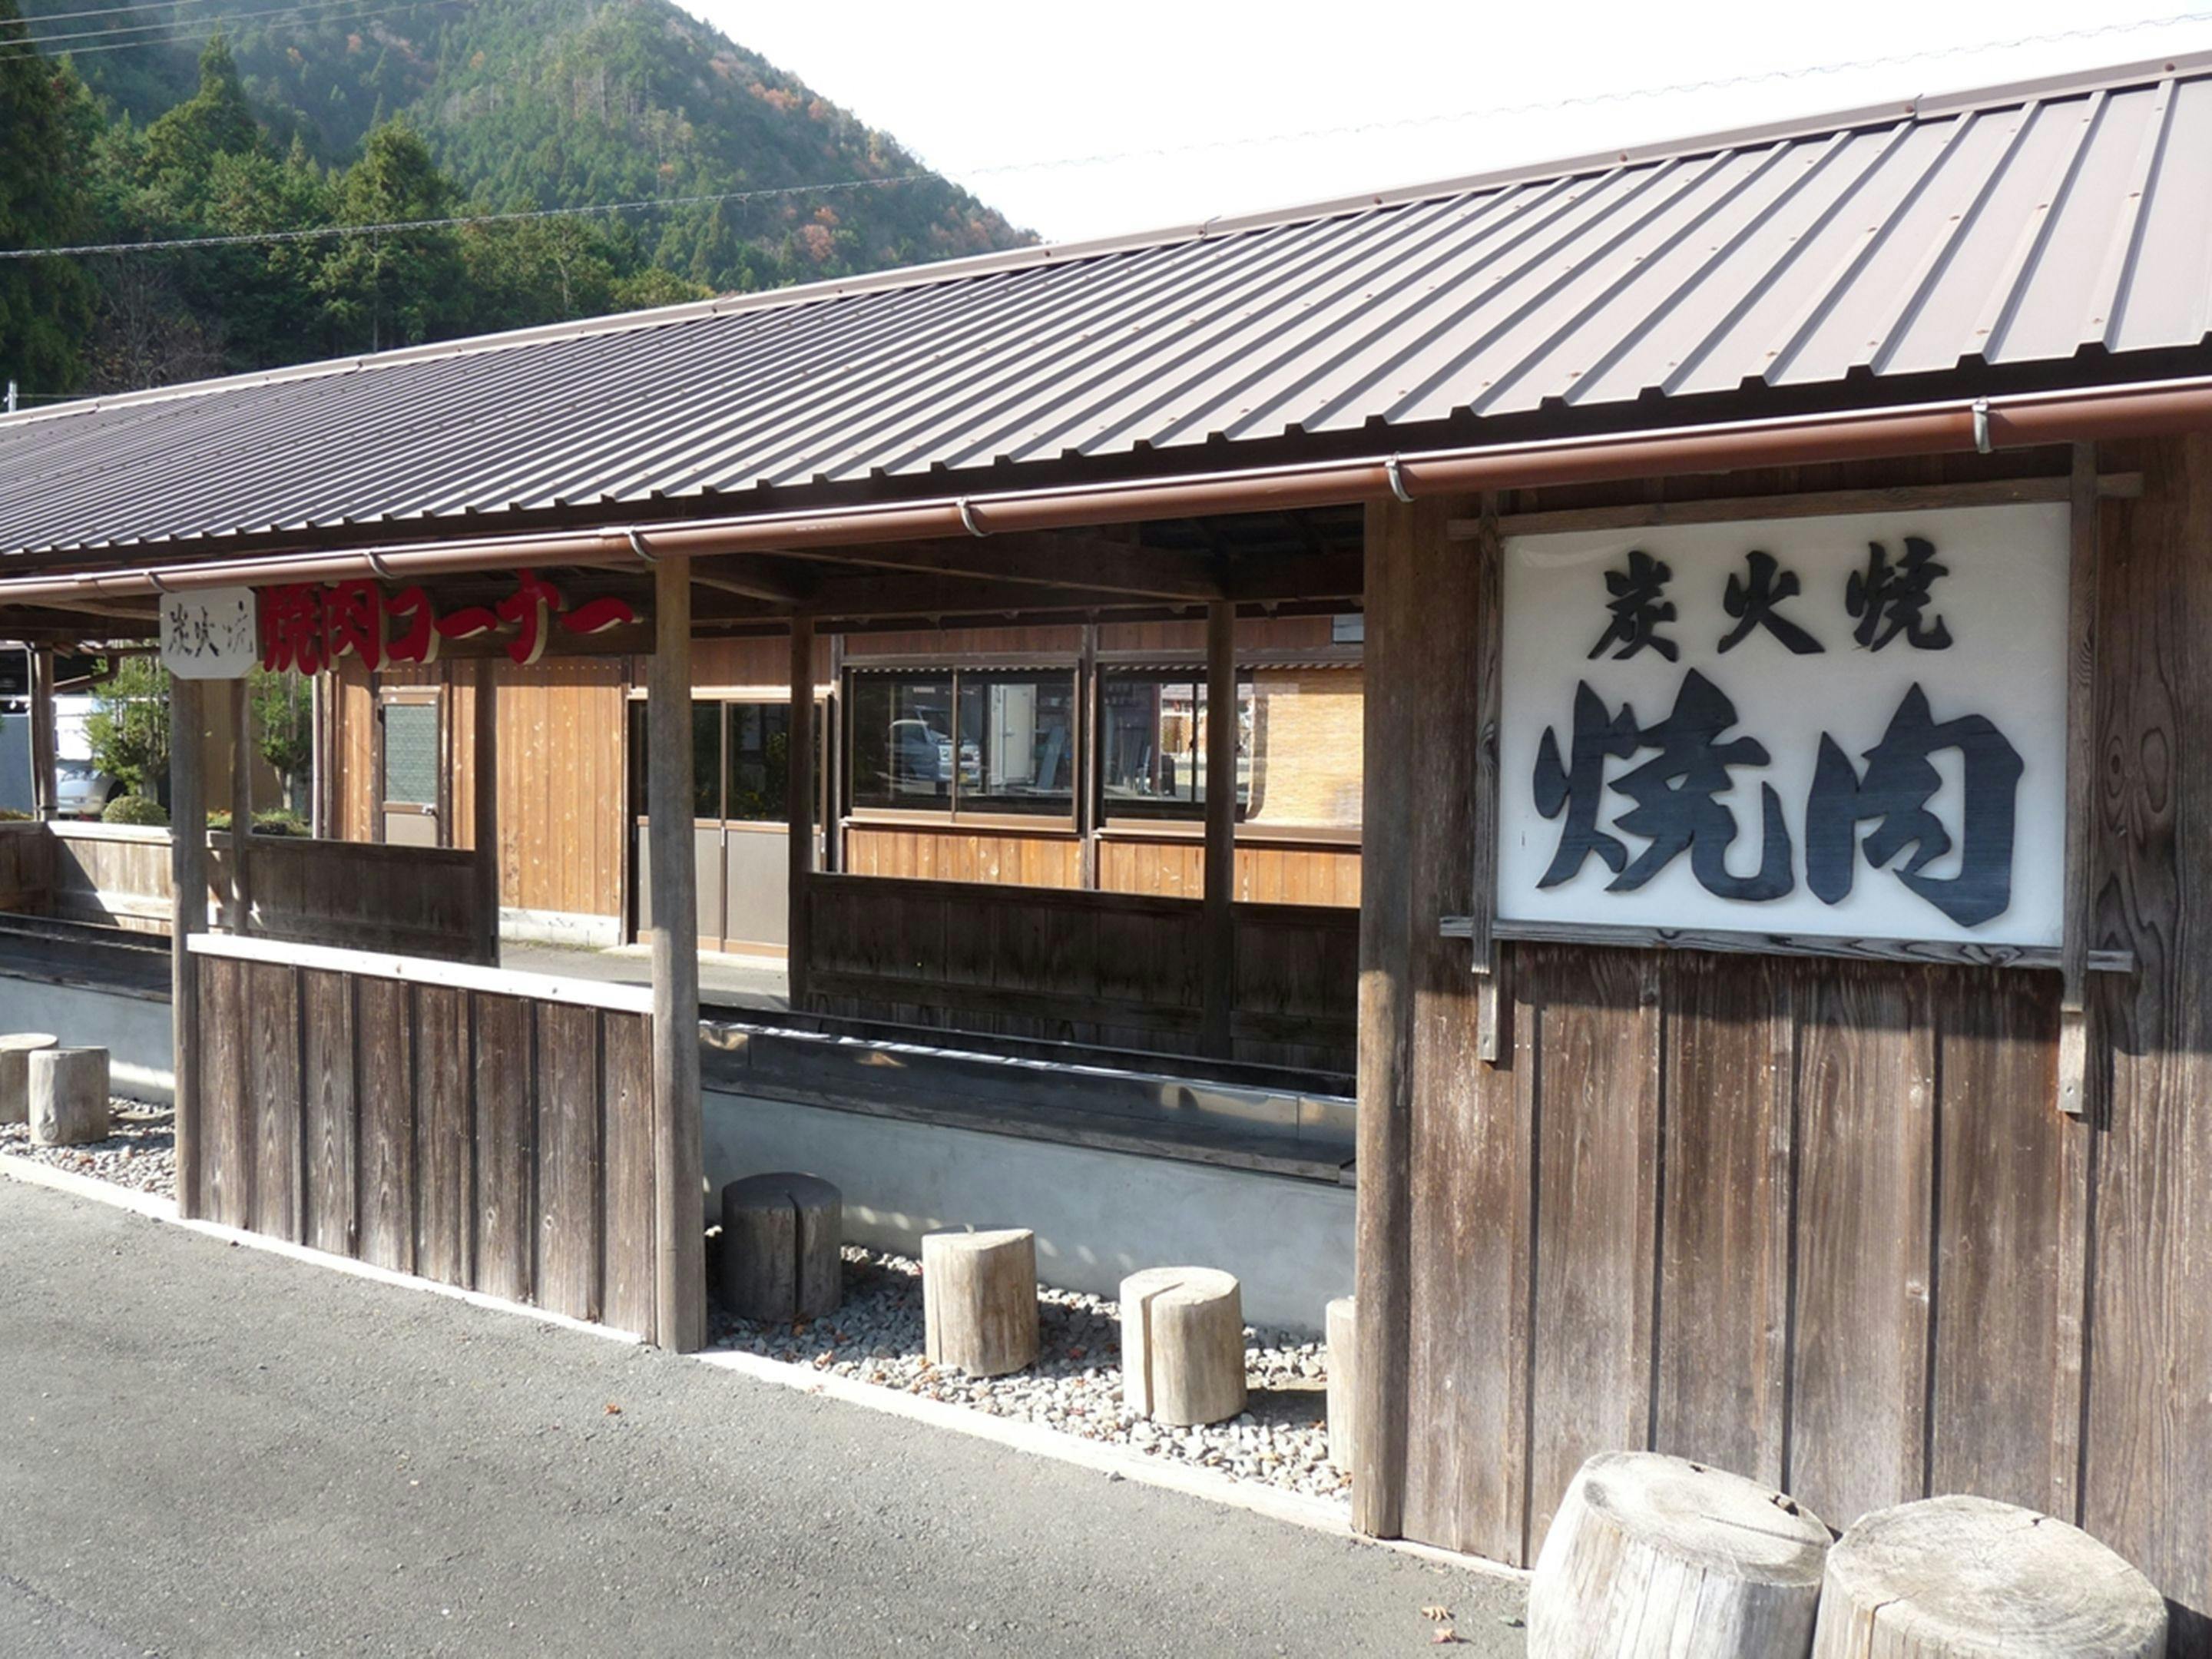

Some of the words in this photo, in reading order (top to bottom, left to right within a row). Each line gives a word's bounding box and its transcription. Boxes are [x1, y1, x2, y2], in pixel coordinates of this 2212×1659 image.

[260, 567, 635, 676] 焼肉コーナー
[1587, 536, 1953, 662] 炭火焼
[1533, 667, 2025, 928] 焼肉
